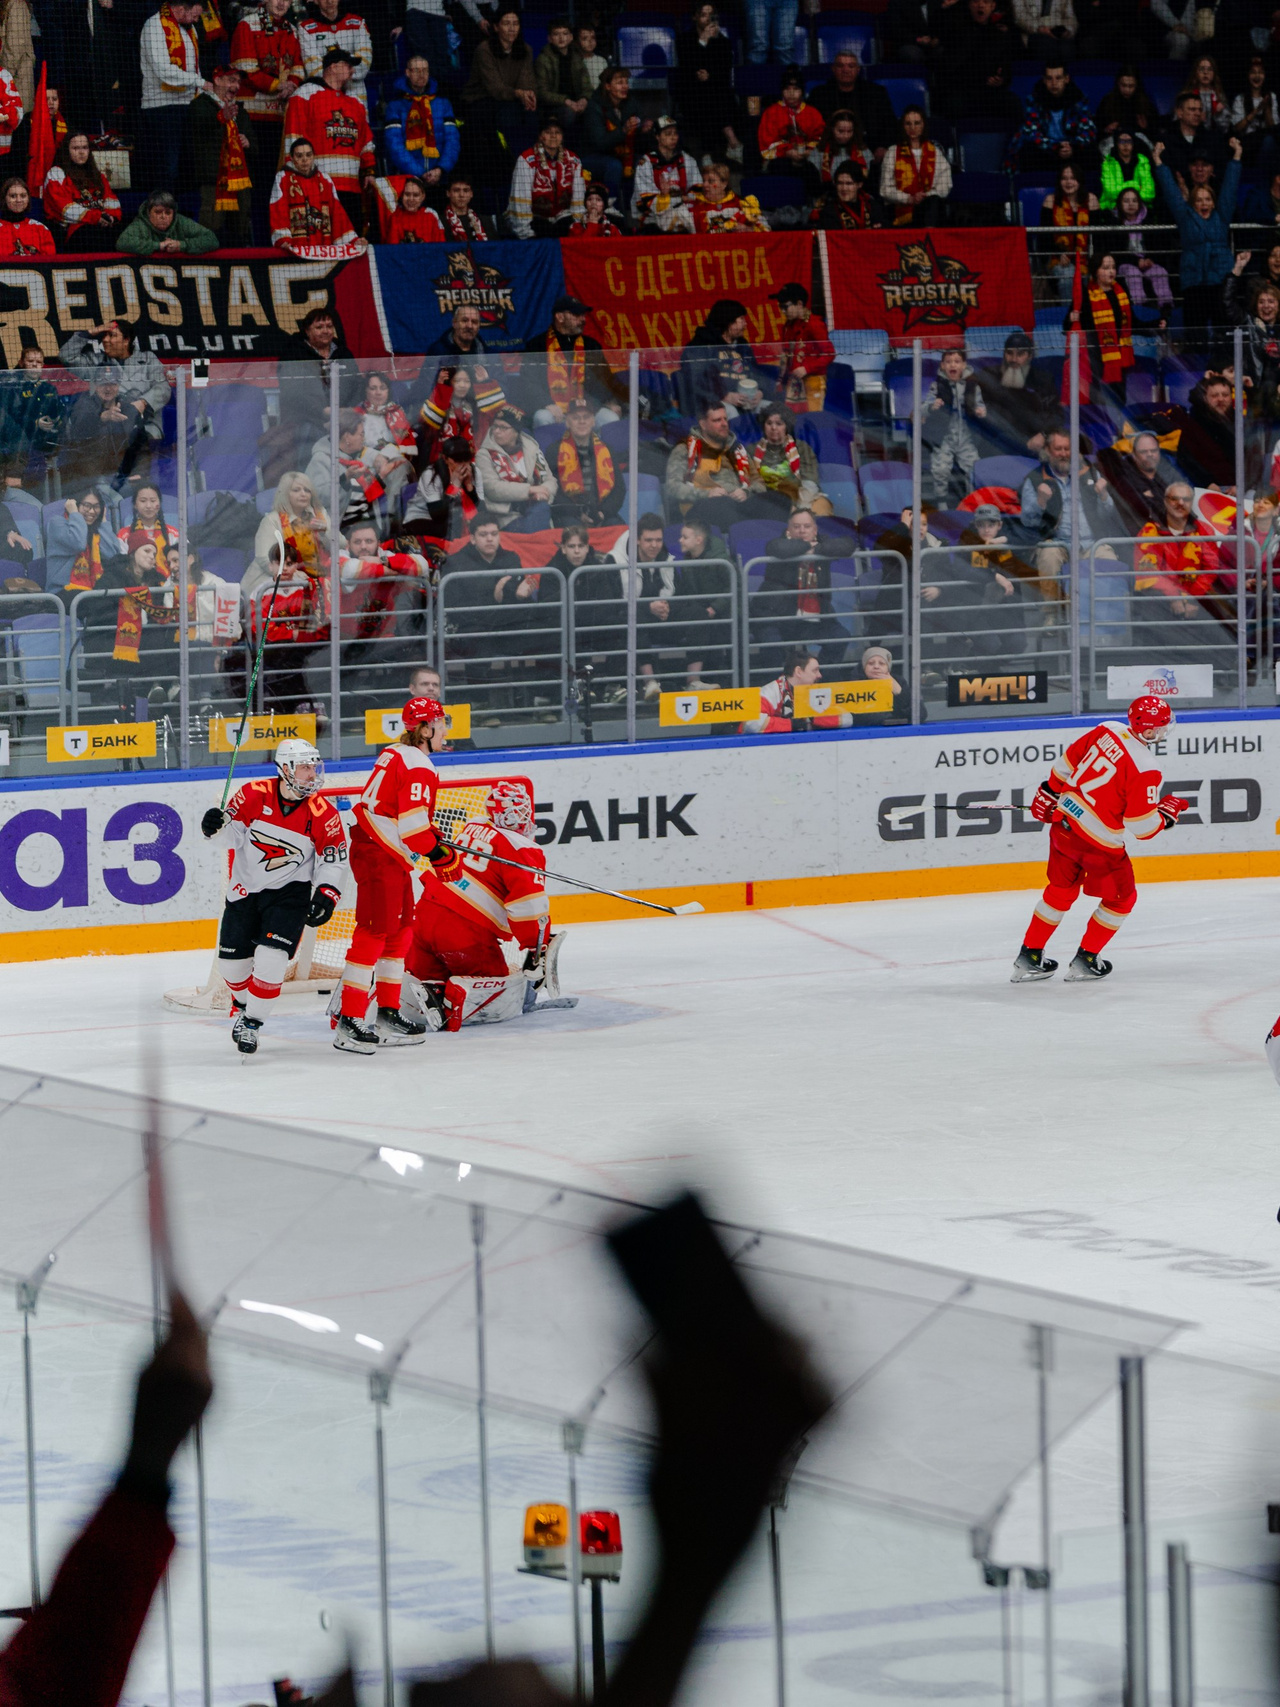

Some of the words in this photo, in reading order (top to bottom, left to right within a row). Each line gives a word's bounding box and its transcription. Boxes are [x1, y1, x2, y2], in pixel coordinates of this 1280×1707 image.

[604, 257, 626, 297] С
[637, 246, 774, 301] ДЕТСТВА
[881, 283, 979, 309] REDSTAR
[596, 309, 642, 349] ЗА
[958, 674, 1037, 703] МАТЧ!
[1143, 679, 1166, 688] АВТО
[1149, 686, 1179, 695] РАДИО
[701, 699, 745, 714] БАНК
[834, 690, 877, 705] БАНК
[91, 733, 138, 749] БАНК
[252, 725, 299, 740] БАНК
[1178, 734, 1263, 755] ШИНЫ
[410, 782, 430, 804] 94
[1147, 785, 1159, 805] 9
[877, 777, 1262, 842] GISLED
[323, 841, 347, 864] 86
[472, 980, 506, 989] CCM
